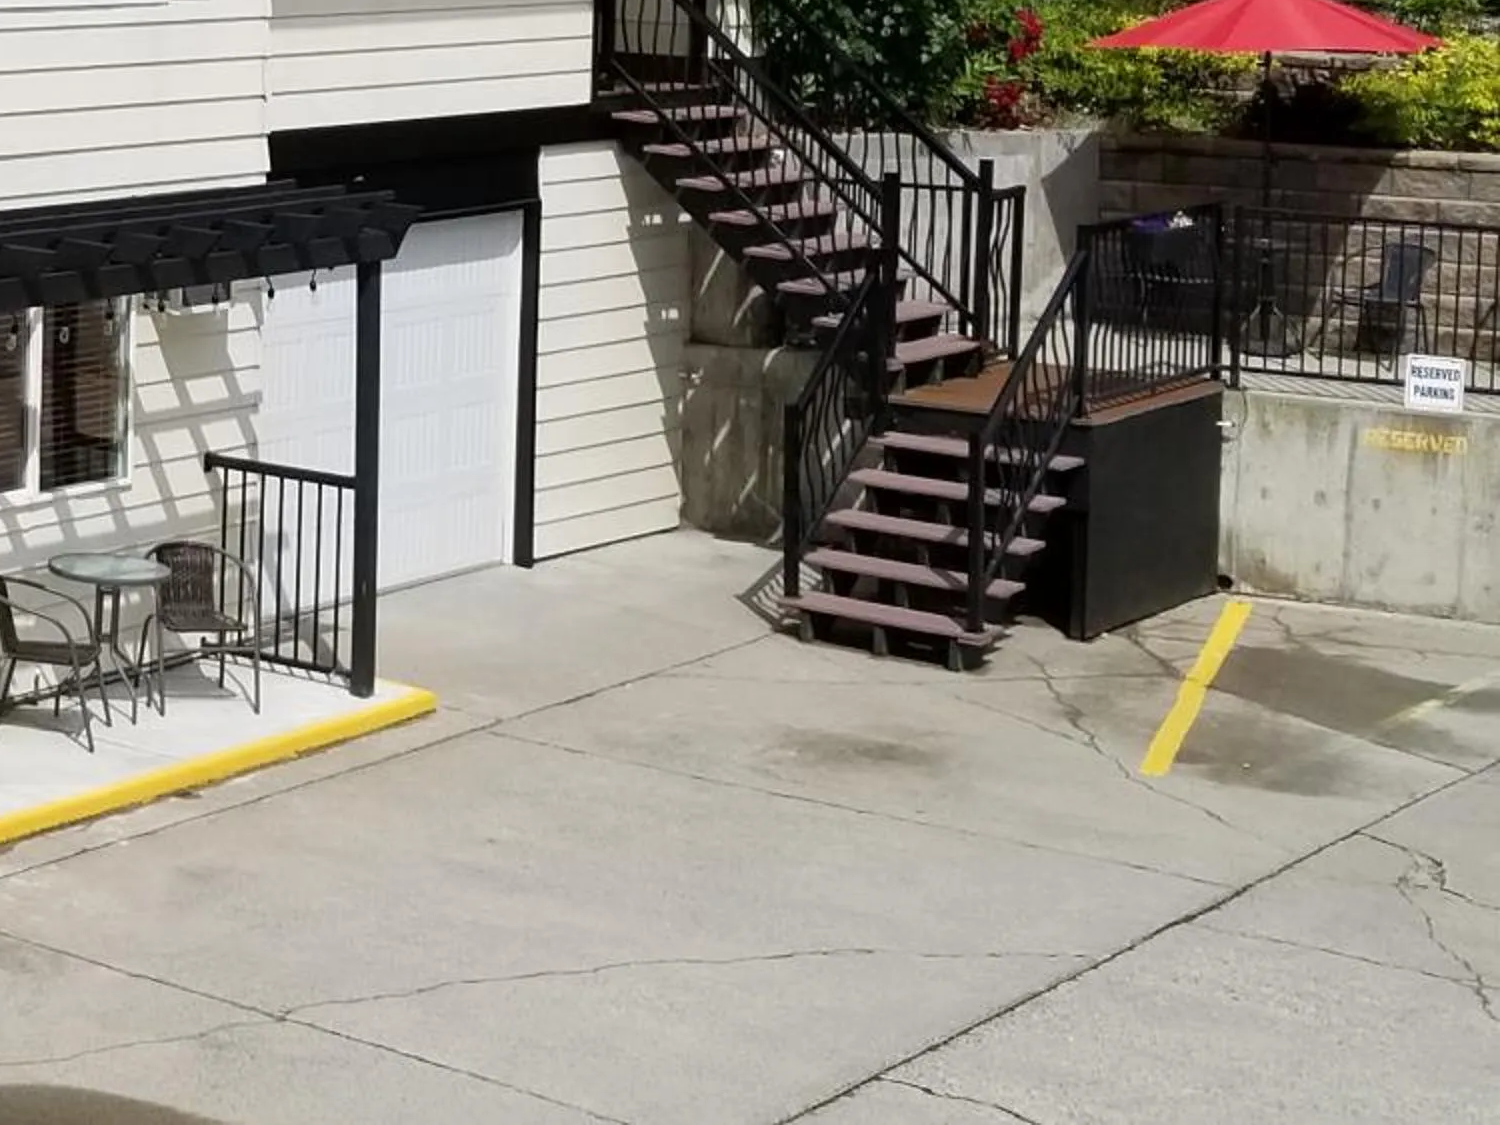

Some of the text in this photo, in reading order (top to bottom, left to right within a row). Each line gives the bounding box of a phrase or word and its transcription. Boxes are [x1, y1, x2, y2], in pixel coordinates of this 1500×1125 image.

[1411, 365, 1461, 382] RESERVED
[1413, 385, 1455, 401] PARKING
[1366, 428, 1468, 455] RESERVED
